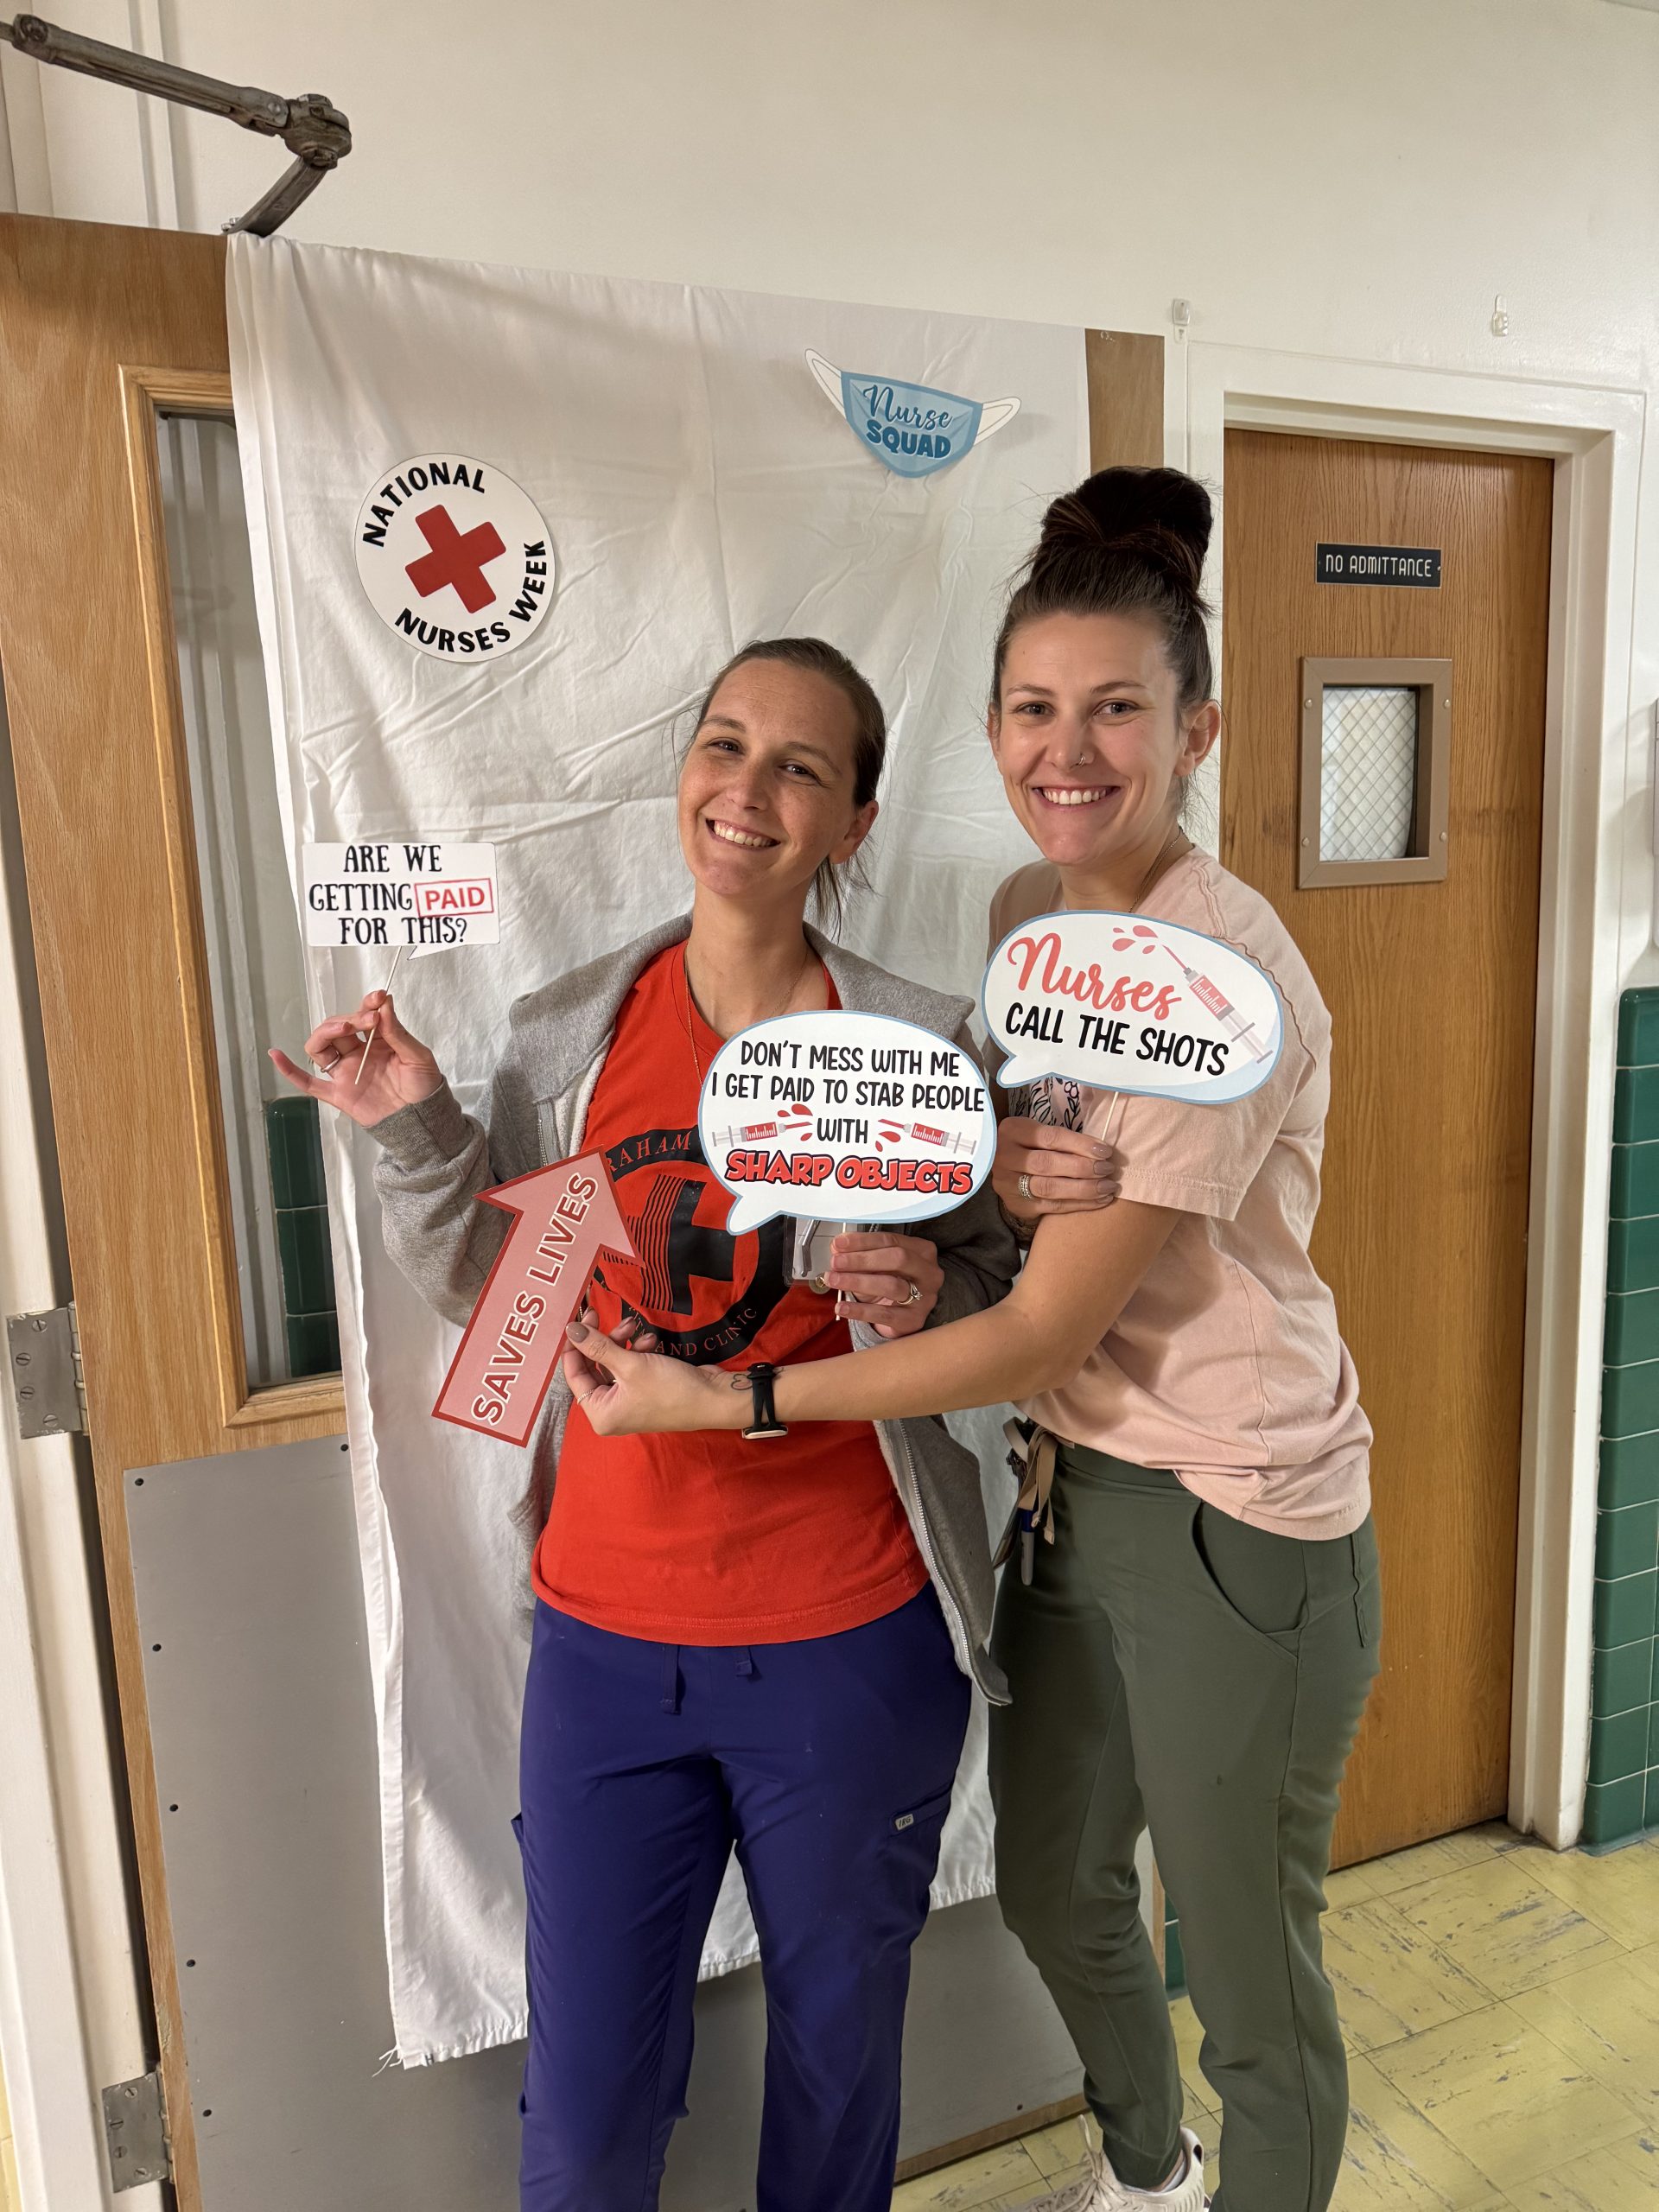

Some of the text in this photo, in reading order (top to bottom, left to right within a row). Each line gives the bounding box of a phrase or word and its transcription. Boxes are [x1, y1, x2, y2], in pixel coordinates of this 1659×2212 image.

[863, 385, 952, 430] Nurse
[866, 419, 951, 459] SQUAD
[362, 462, 486, 547] NATIONAL
[1325, 554, 1432, 577] NO ADMITTANCE
[394, 540, 547, 652] NURSES WEEK
[343, 845, 442, 873] ARE WE
[308, 883, 486, 911] GETTING PAID
[338, 917, 467, 944] FOR THIS?
[1007, 932, 1182, 1020] Nurses
[741, 1040, 960, 1077] DON'T MESS WITH ME
[1005, 1001, 1229, 1076] CALL THE SHOTS
[711, 1071, 985, 1113] I GET PAID TO STAB PEOPLE
[607, 1130, 692, 1173] RAHAM
[817, 1117, 868, 1144] WITH
[725, 1148, 974, 1195] SHARP OBJECTS
[470, 1172, 599, 1427] SAVES LIVES
[654, 1341, 697, 1357] AND
